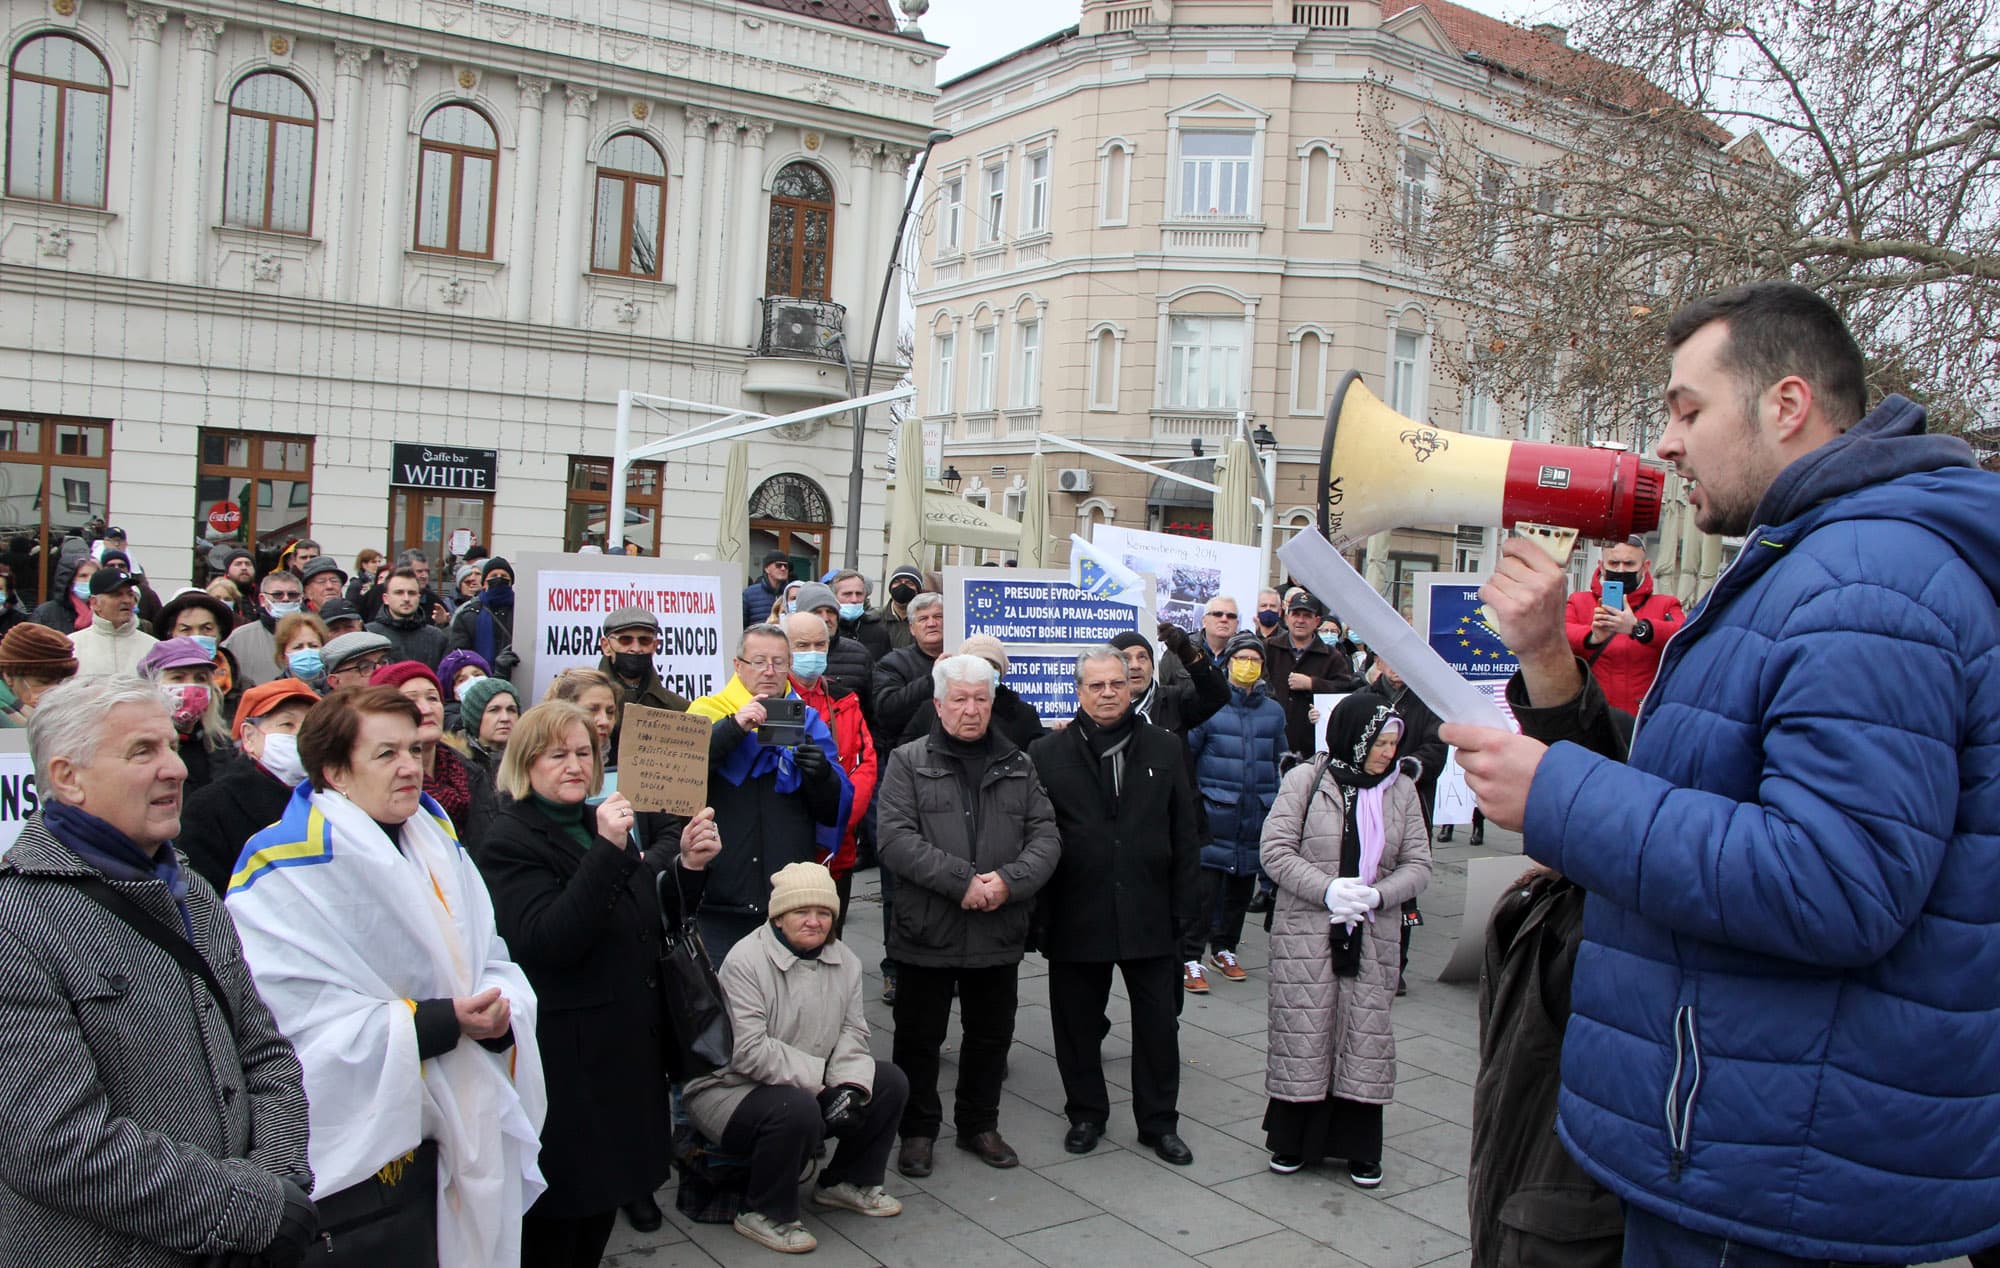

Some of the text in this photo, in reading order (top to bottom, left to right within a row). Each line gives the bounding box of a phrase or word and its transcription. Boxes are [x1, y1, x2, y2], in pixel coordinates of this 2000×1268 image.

[403, 463, 487, 489] WHITE
[1004, 586, 1049, 600] PRESUDE
[1462, 591, 1478, 601] THE
[547, 587, 602, 612] KONCEPT
[656, 591, 716, 615] TERITORIJA
[977, 598, 992, 608] EU
[1004, 606, 1135, 622] ZA LJUDSKA PRAVA-OSNOVA
[970, 624, 981, 637] ZA
[984, 621, 1037, 639] BUDUĆNOST
[1038, 626, 1067, 639] BOSNE
[1069, 627, 1072, 638] I
[656, 626, 718, 656] GENOCID
[1030, 663, 1041, 675] OF
[1042, 663, 1059, 675] THE
[1470, 663, 1491, 673] AND
[1012, 681, 1043, 694] HUMAN
[1044, 682, 1074, 695] RIGHTS
[1044, 702, 1072, 714] BOSNIA
